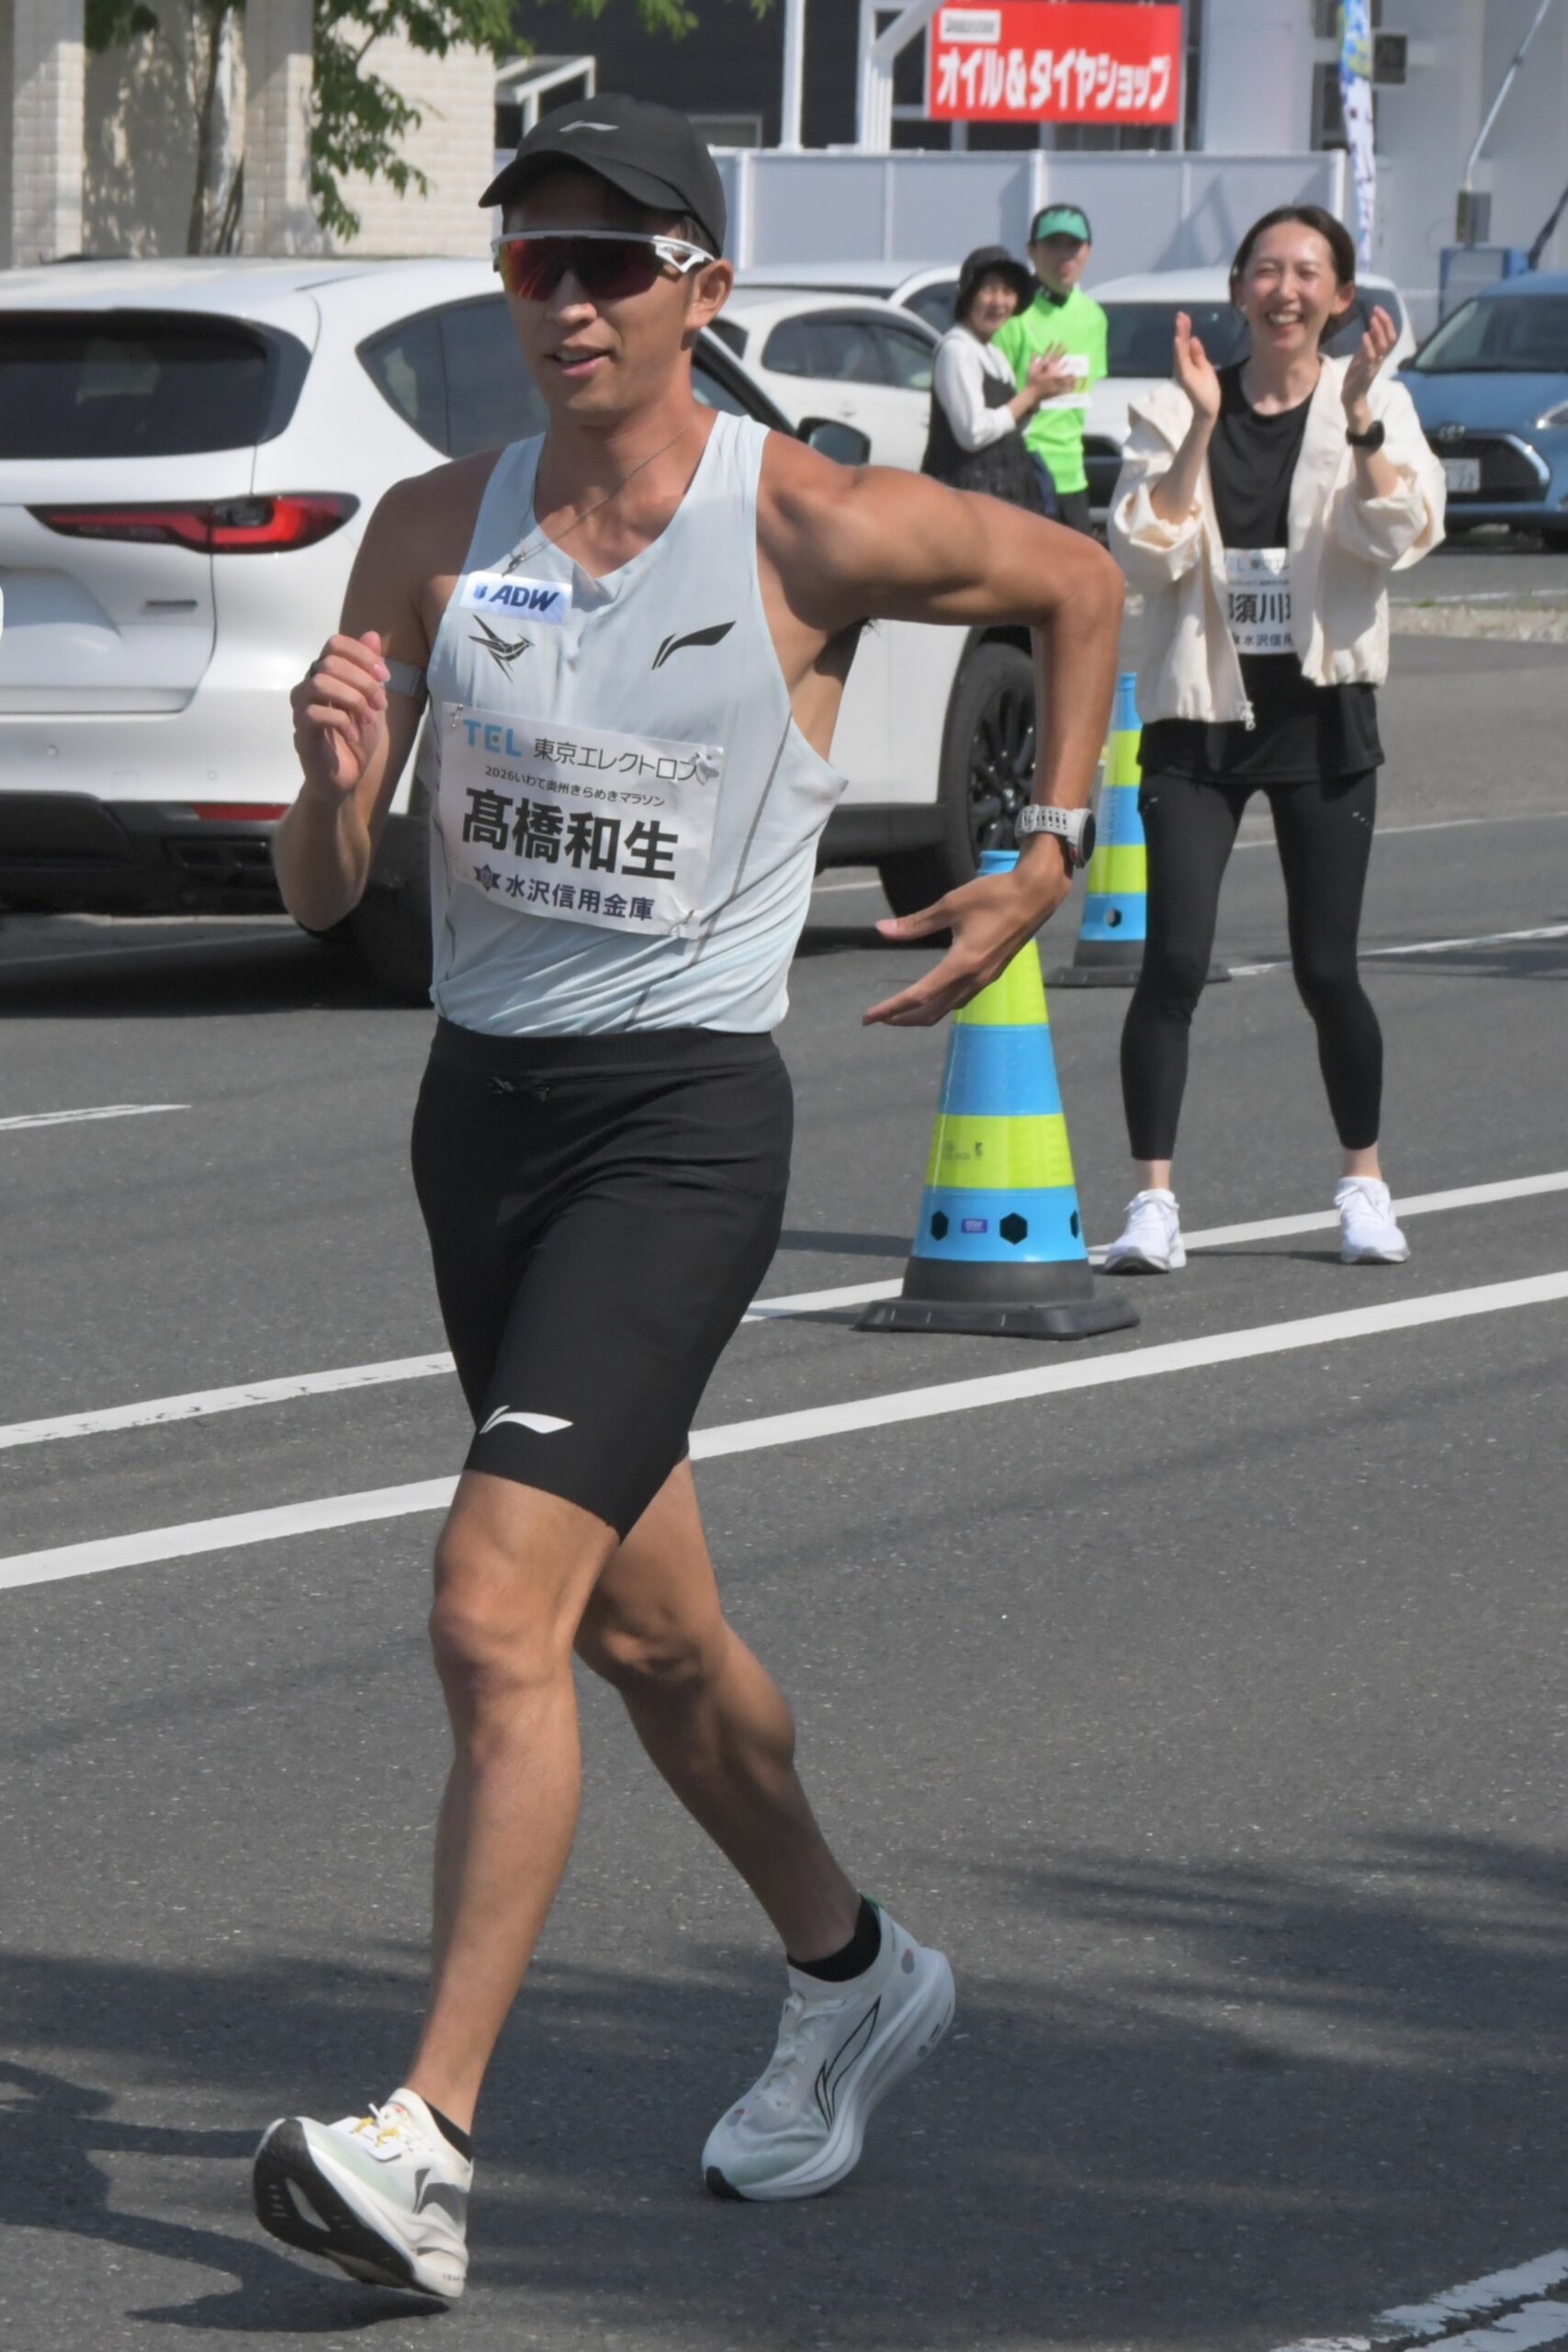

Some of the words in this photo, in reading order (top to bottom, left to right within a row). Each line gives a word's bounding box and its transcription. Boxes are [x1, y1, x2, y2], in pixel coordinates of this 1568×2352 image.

[937, 47, 1171, 110] オイル&タイヤショップ
[489, 584, 559, 612] ADW
[1228, 593, 1291, 624] 須川
[463, 718, 522, 758] TEL
[533, 738, 697, 781] 東京エレクトロン
[485, 764, 666, 807] 2026いわて奥州きらめきマラソン
[505, 874, 656, 922] 水沢信用金庫
